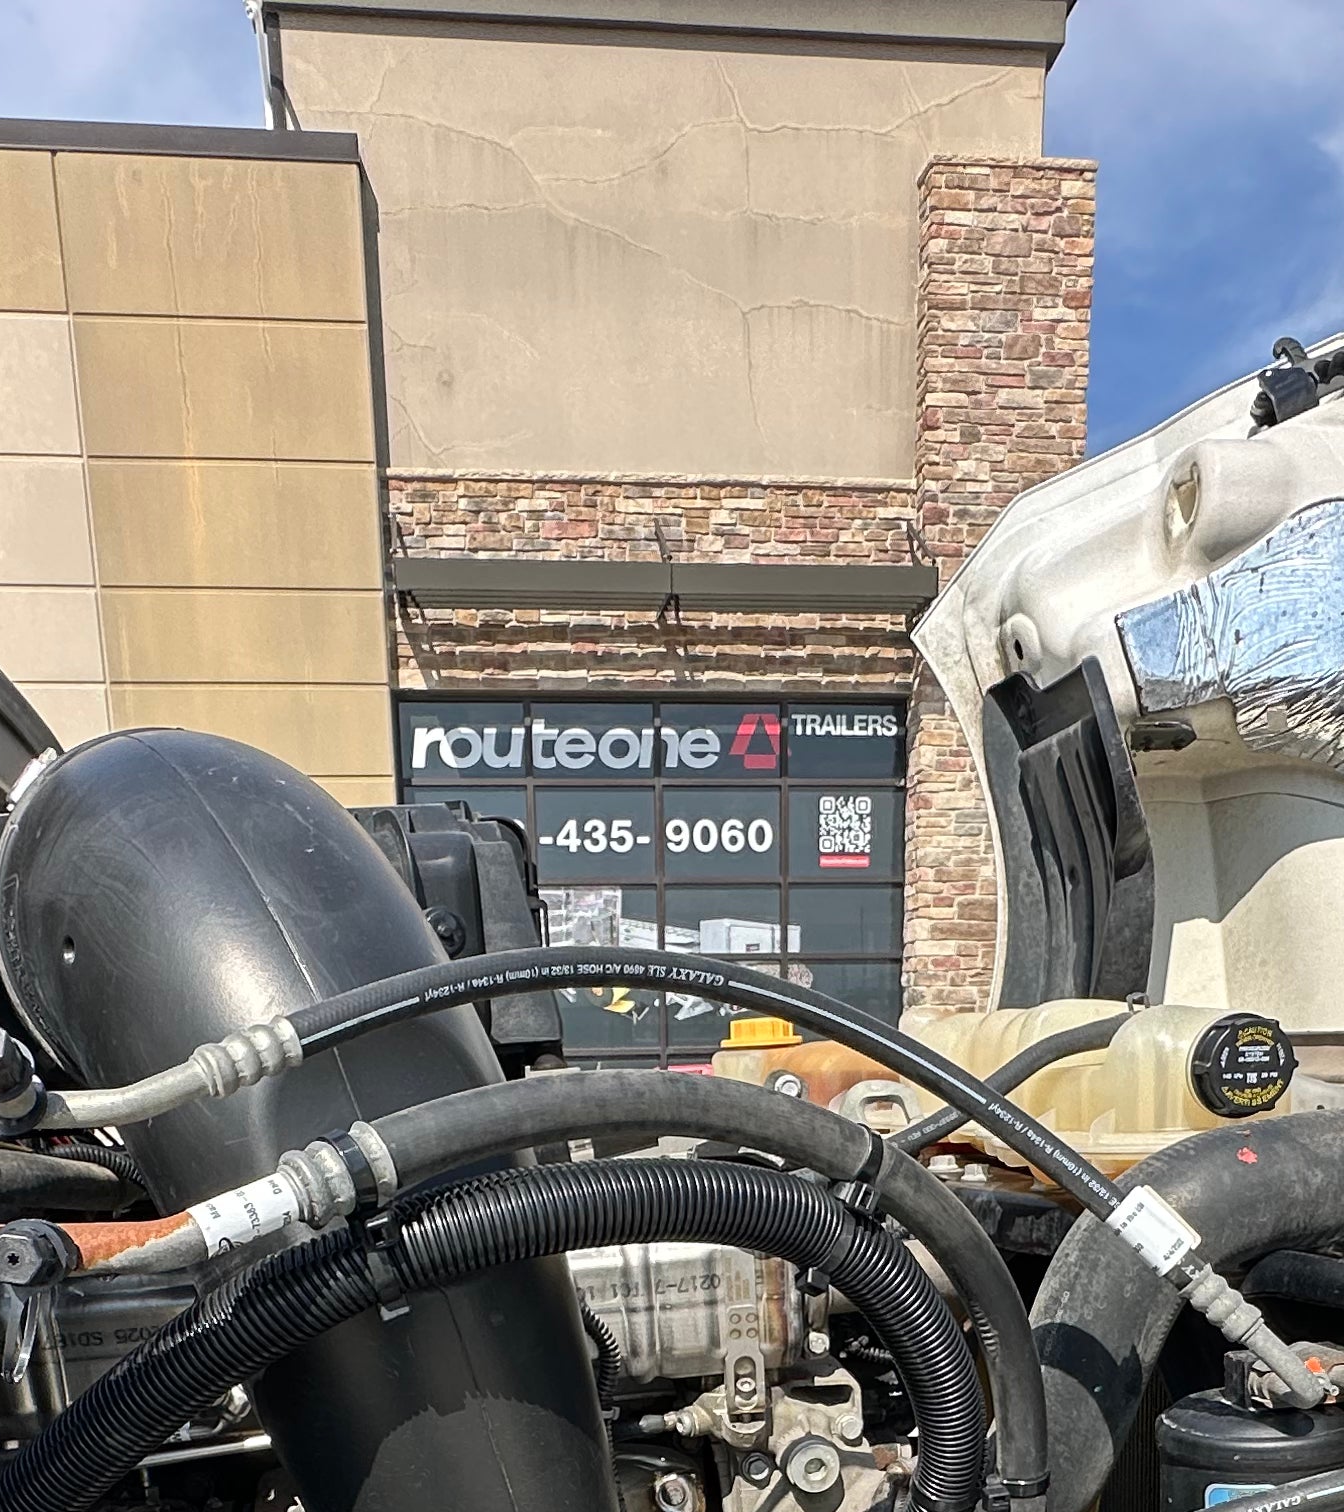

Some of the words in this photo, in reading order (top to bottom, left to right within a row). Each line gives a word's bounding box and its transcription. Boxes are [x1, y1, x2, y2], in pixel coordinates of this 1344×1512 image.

[791, 714, 898, 738] TRAILERS
[411, 719, 721, 769] routeone
[505, 966, 539, 982] (10mm)
[541, 966, 550, 975] in
[550, 964, 574, 976] 13/32
[577, 964, 604, 974] HOSE
[605, 964, 622, 974] A/C
[647, 964, 666, 977] SLE
[472, 973, 503, 988] R-134a
[668, 967, 724, 986] GALAXY
